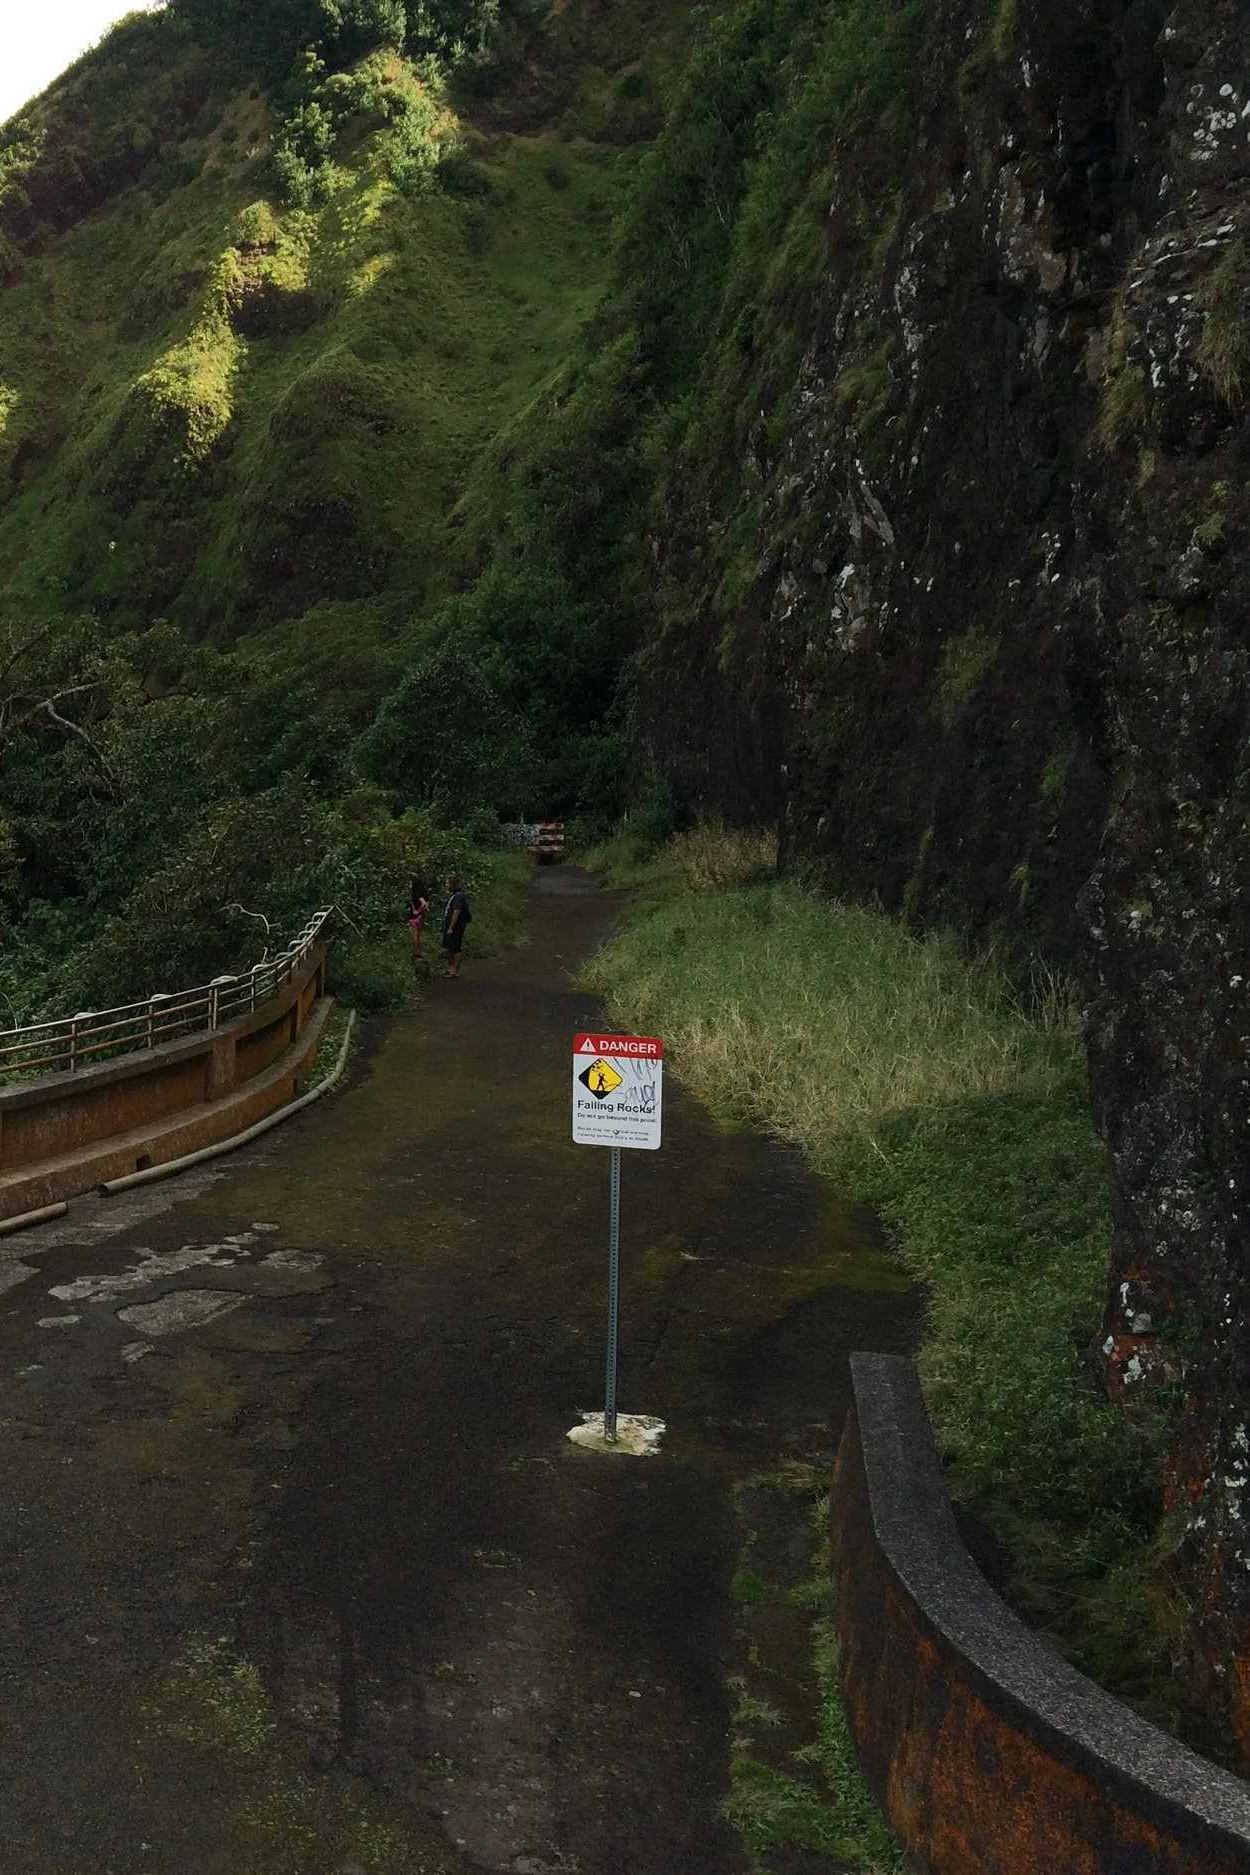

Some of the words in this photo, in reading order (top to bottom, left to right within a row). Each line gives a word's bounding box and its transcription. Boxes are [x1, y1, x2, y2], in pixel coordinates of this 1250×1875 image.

[599, 1040, 657, 1054] DANGER
[577, 1100, 614, 1113] Falling
[617, 1102, 656, 1114] Rocks!
